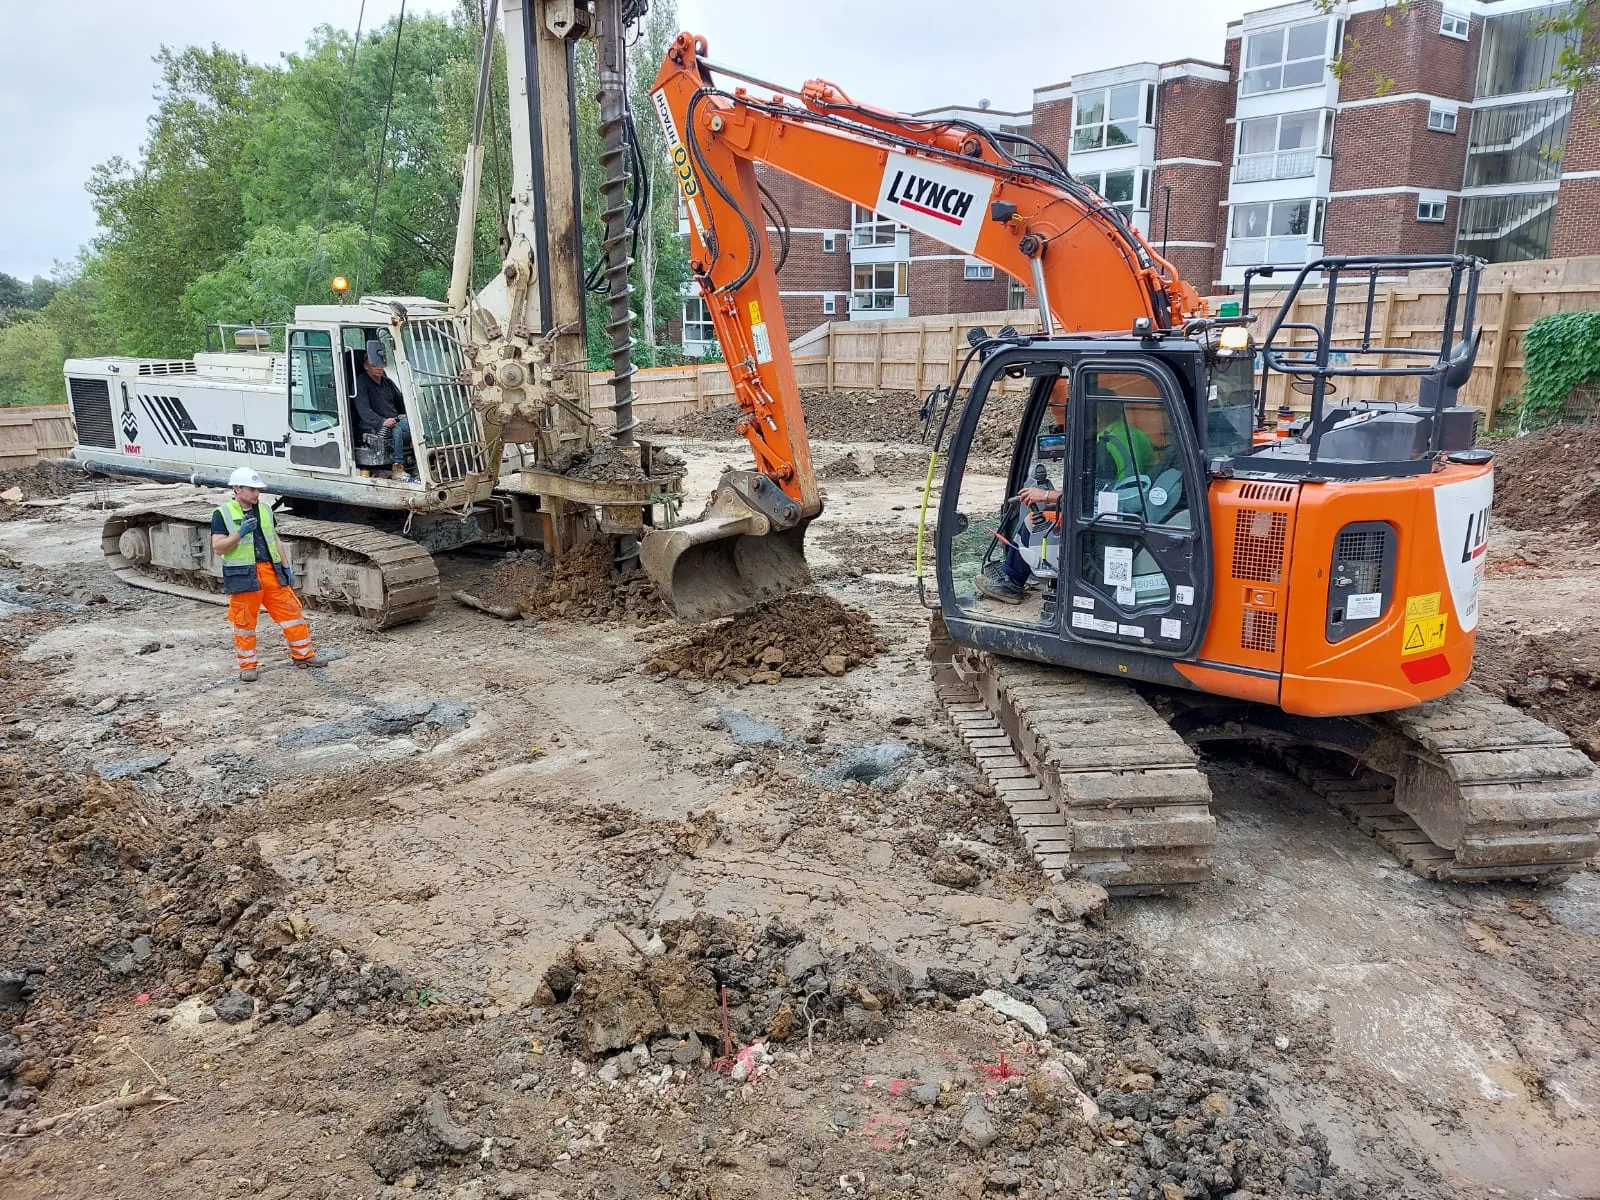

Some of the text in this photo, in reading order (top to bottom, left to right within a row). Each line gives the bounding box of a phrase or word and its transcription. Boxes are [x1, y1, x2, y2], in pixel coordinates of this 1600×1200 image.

[656, 93, 677, 145] HITACHI
[233, 440, 267, 454] HR 130
